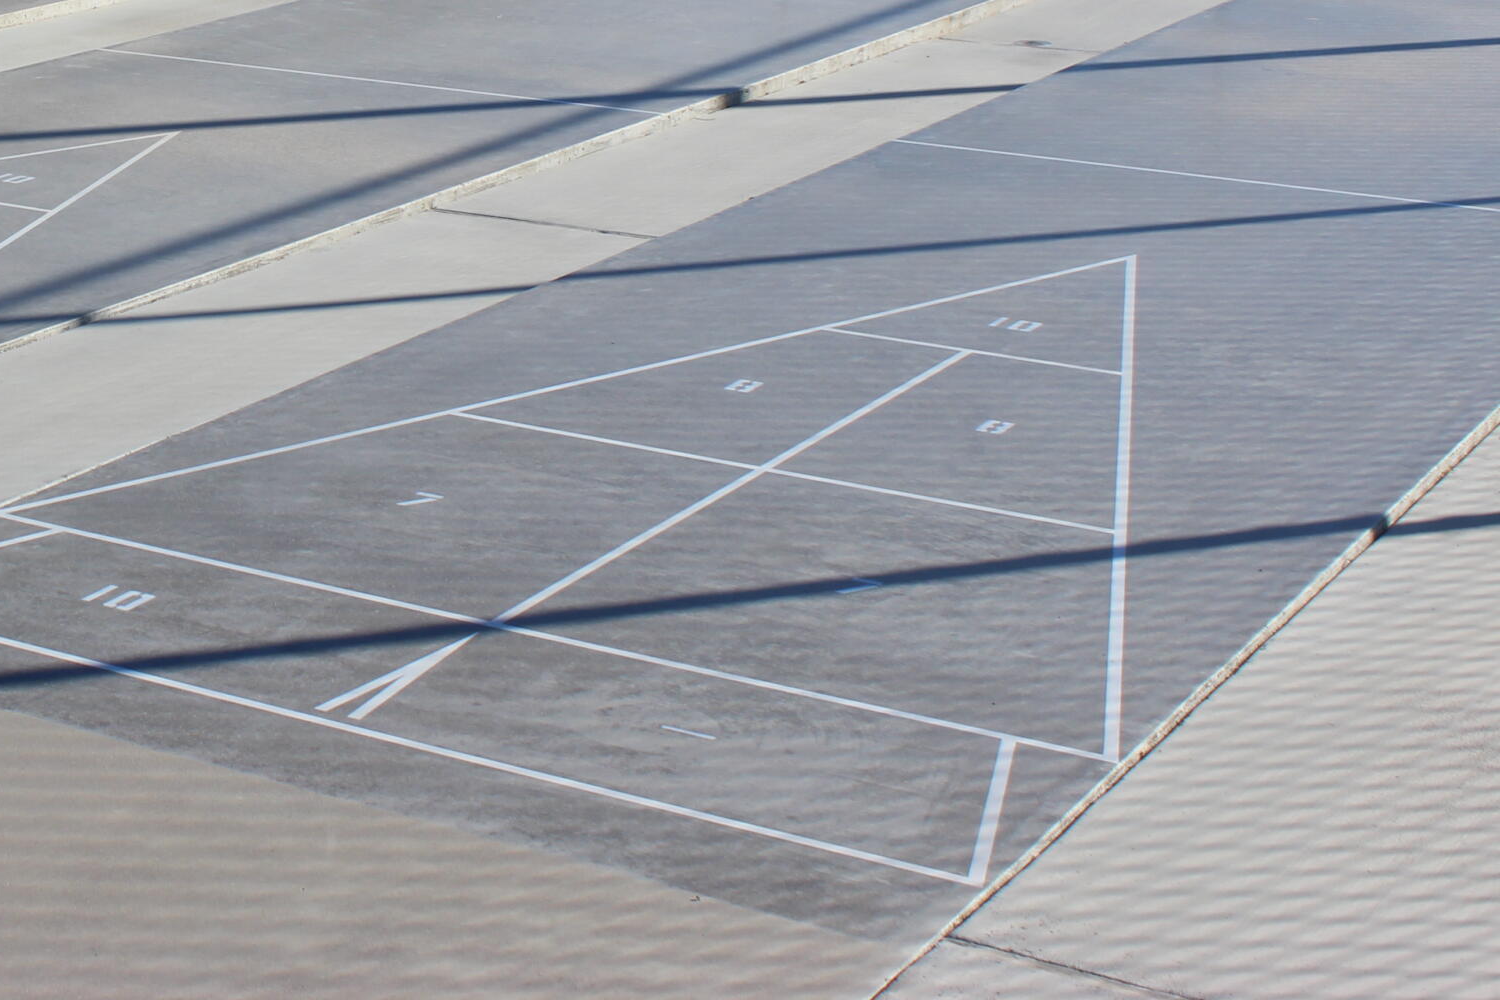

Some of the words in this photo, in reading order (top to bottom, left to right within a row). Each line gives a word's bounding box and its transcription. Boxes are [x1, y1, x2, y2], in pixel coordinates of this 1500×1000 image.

[988, 316, 1043, 333] 10
[723, 378, 764, 394] 8
[975, 419, 1016, 435] 8
[395, 490, 445, 506] 7
[81, 584, 156, 611] 10
